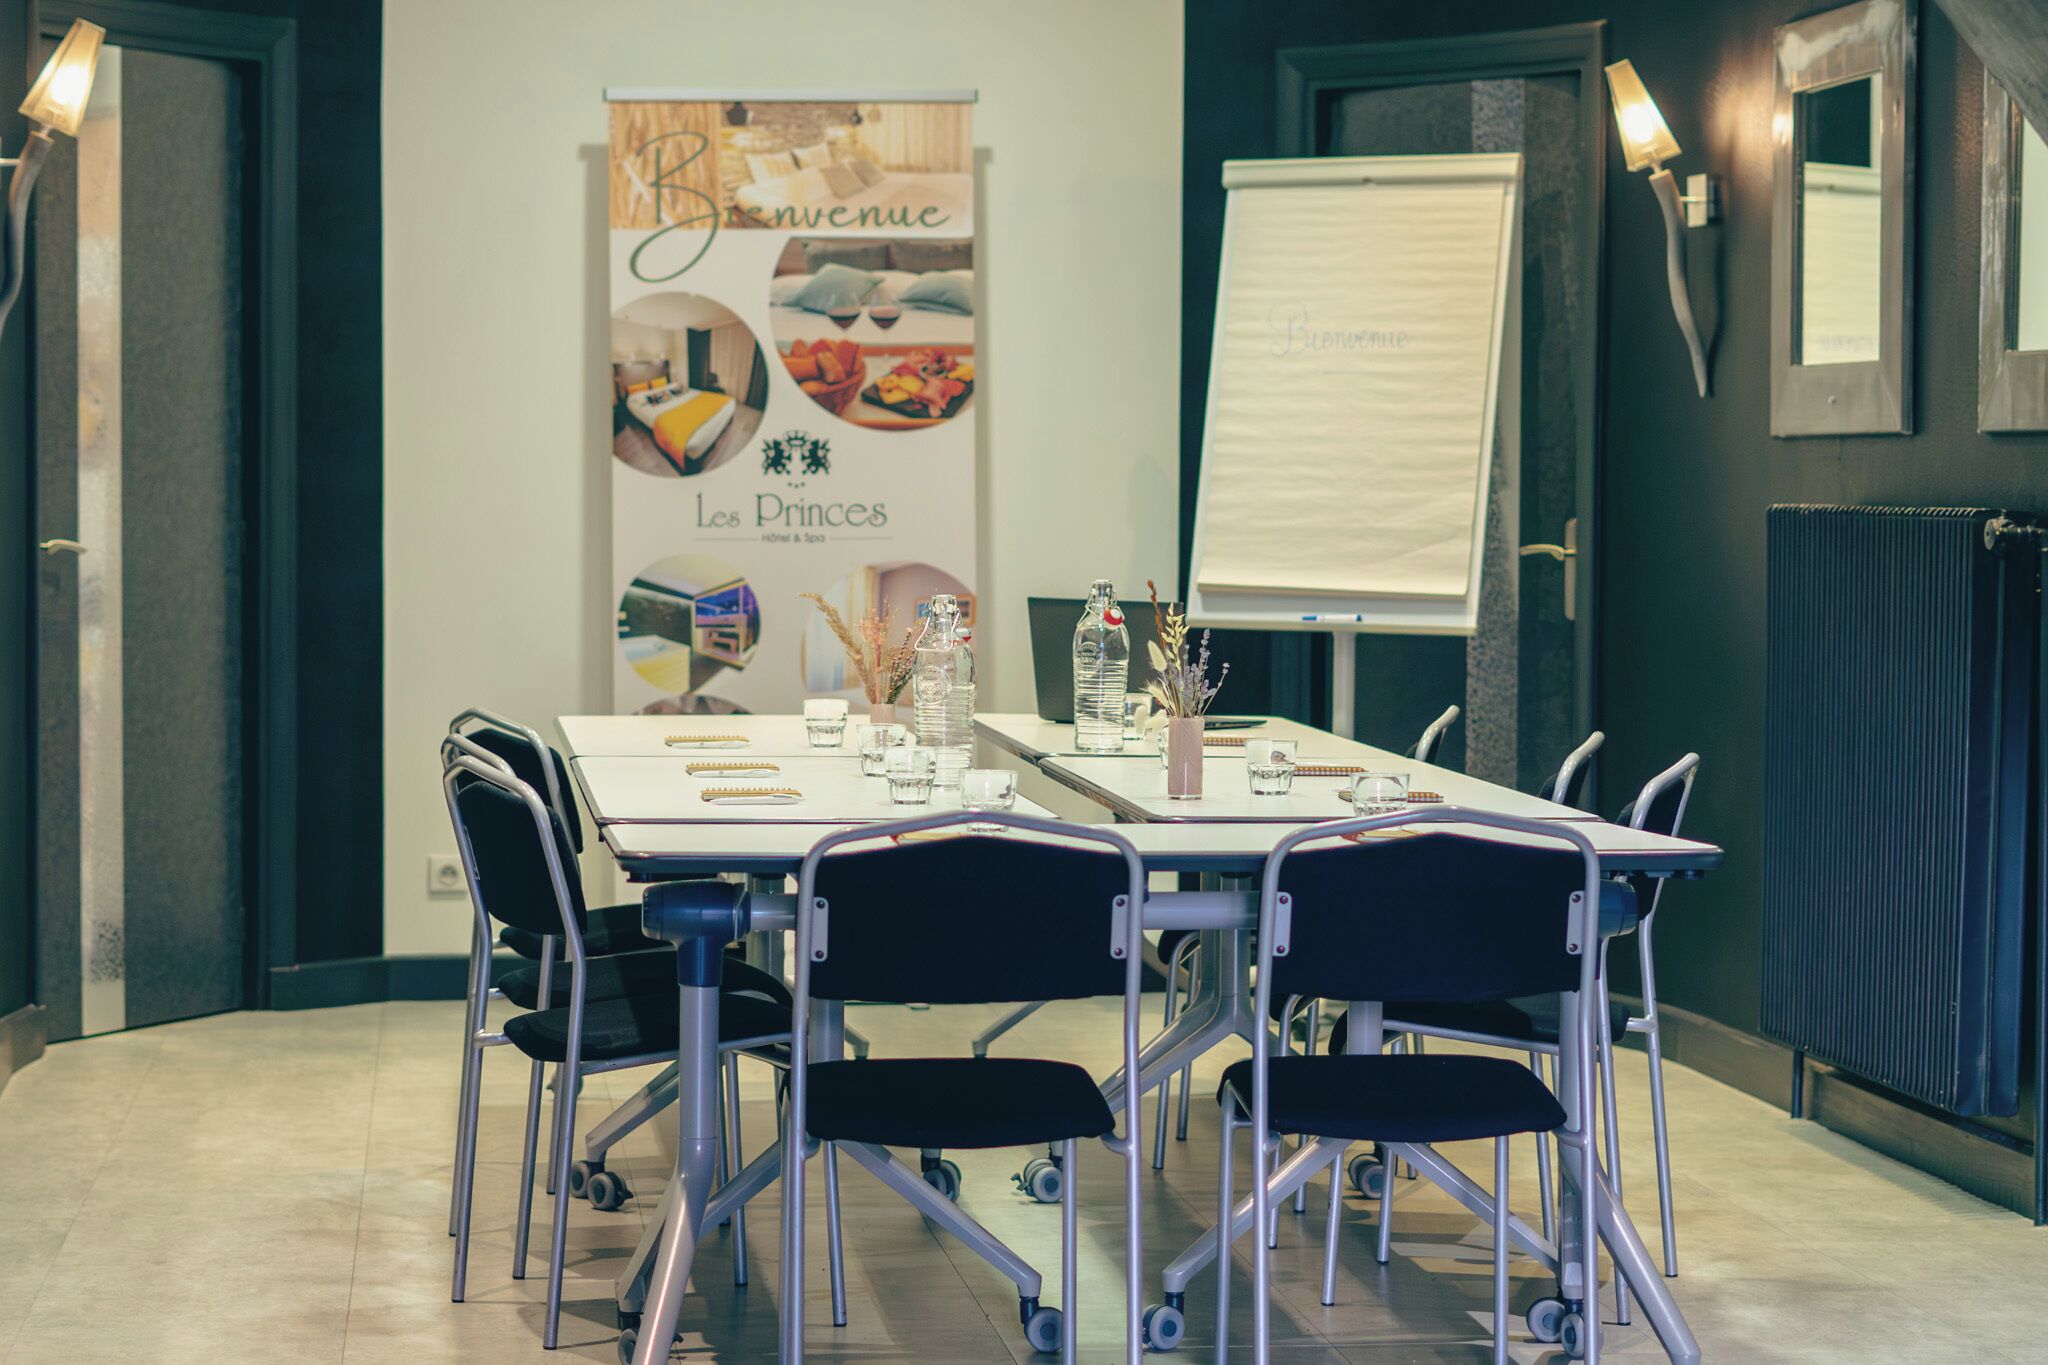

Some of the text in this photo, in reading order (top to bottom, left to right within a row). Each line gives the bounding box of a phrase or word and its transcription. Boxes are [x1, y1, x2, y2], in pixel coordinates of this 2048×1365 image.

[629, 130, 951, 283] Bienvenue
[1267, 299, 1408, 358] Bienvenue
[696, 491, 888, 528] Les Princes
[793, 533, 802, 543] &
[804, 532, 826, 544] Spa
